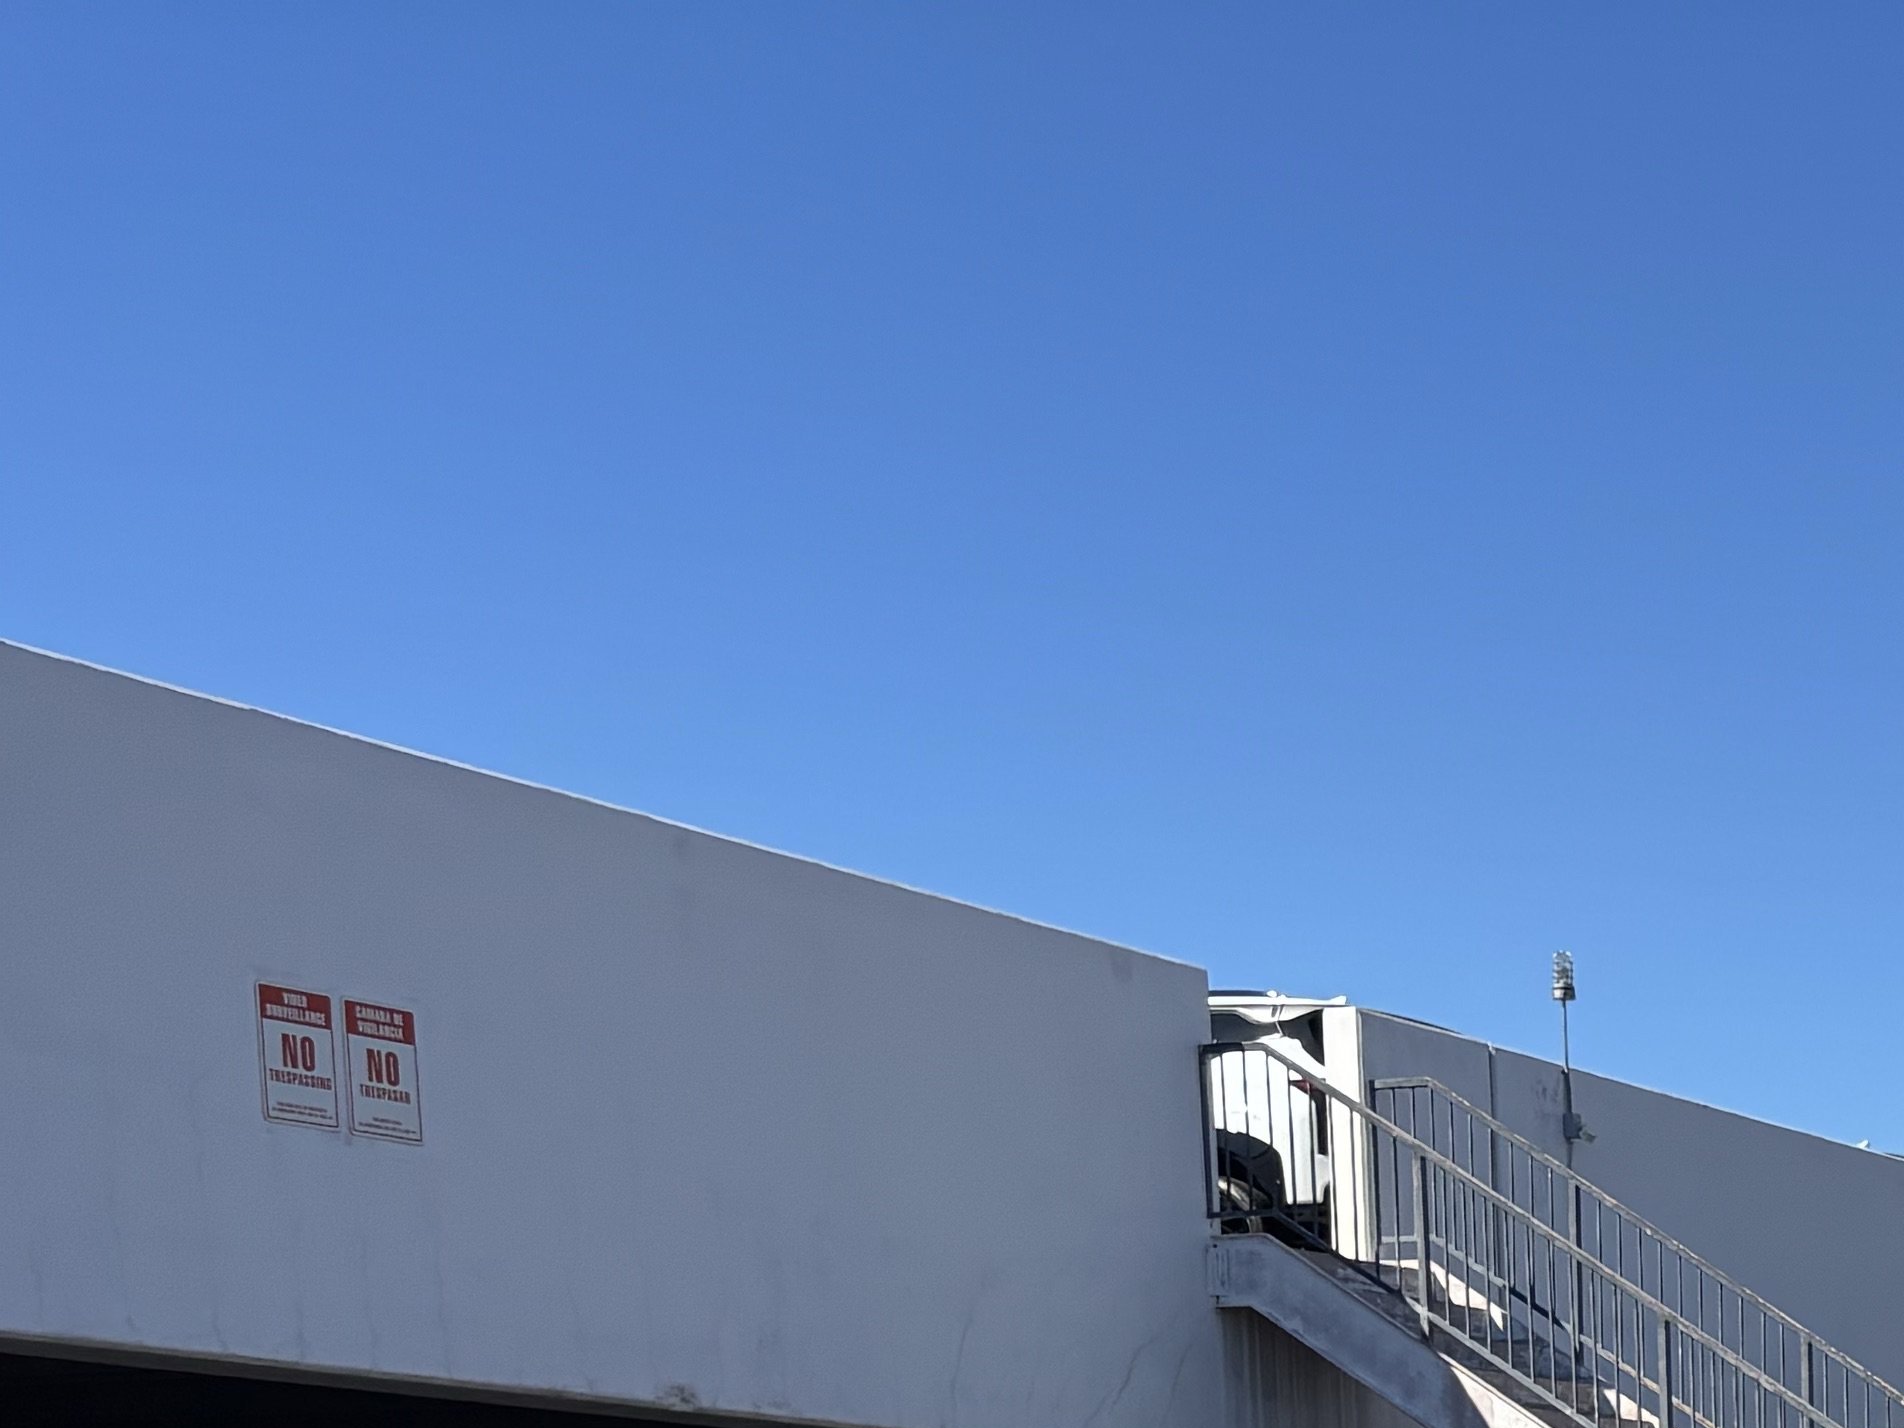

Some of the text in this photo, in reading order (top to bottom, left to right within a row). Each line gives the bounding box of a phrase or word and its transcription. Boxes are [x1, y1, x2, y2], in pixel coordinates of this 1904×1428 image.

[281, 1032, 316, 1072] NO
[366, 1048, 401, 1087] NO
[269, 1068, 332, 1091] TRESPASSING
